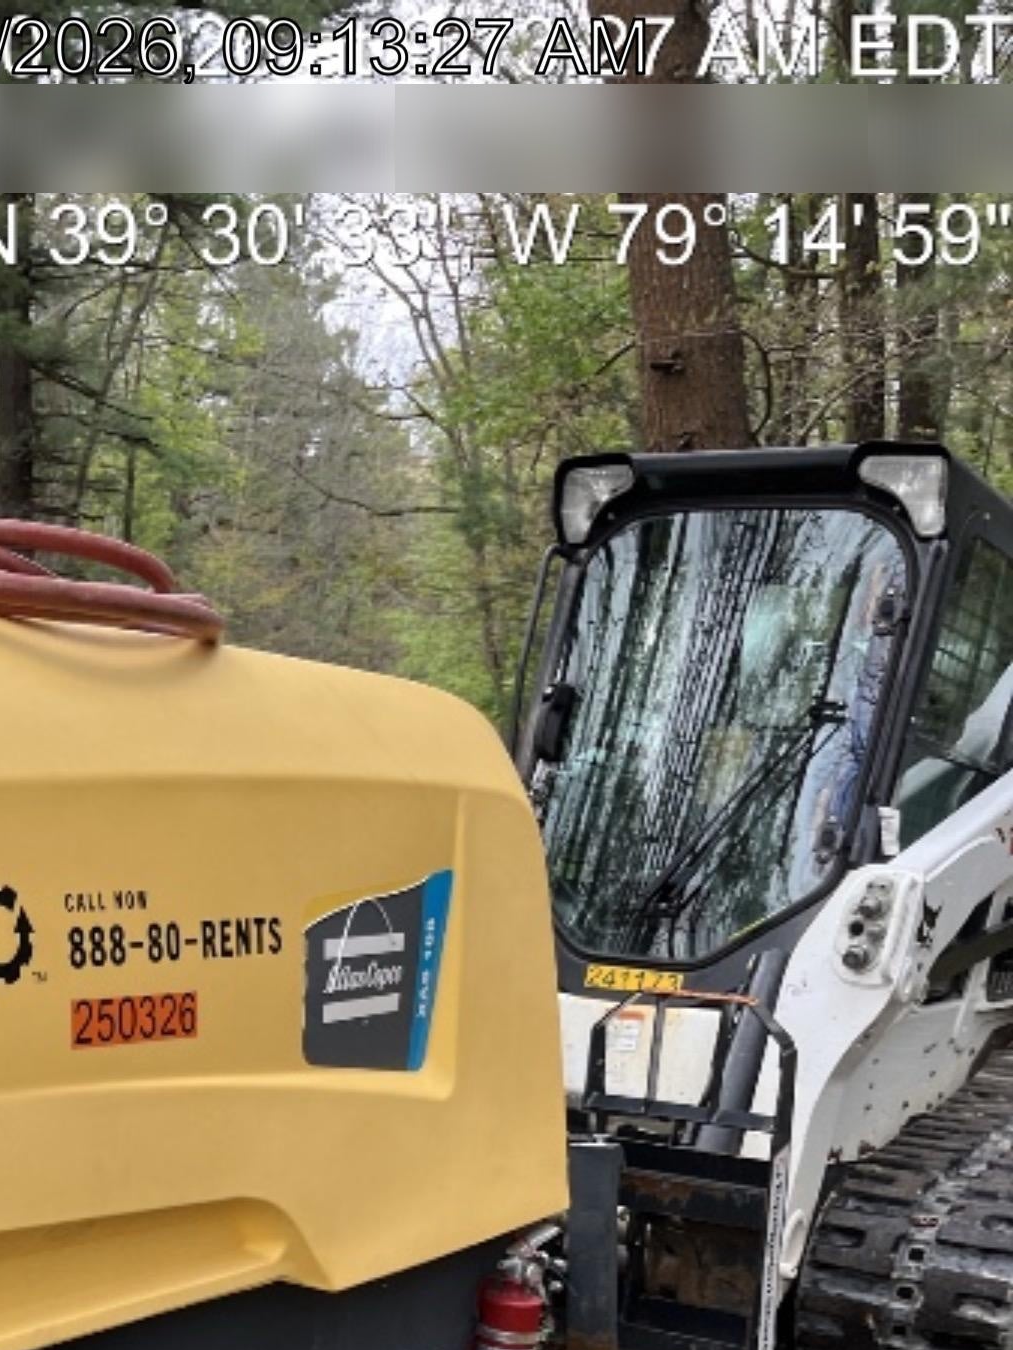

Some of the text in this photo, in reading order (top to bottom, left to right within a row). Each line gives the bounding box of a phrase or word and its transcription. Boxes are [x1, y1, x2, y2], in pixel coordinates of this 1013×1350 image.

[64, 889, 149, 913] CALL NOW
[67, 916, 283, 970] 888-80-RENTS
[73, 991, 197, 1046] 250326
